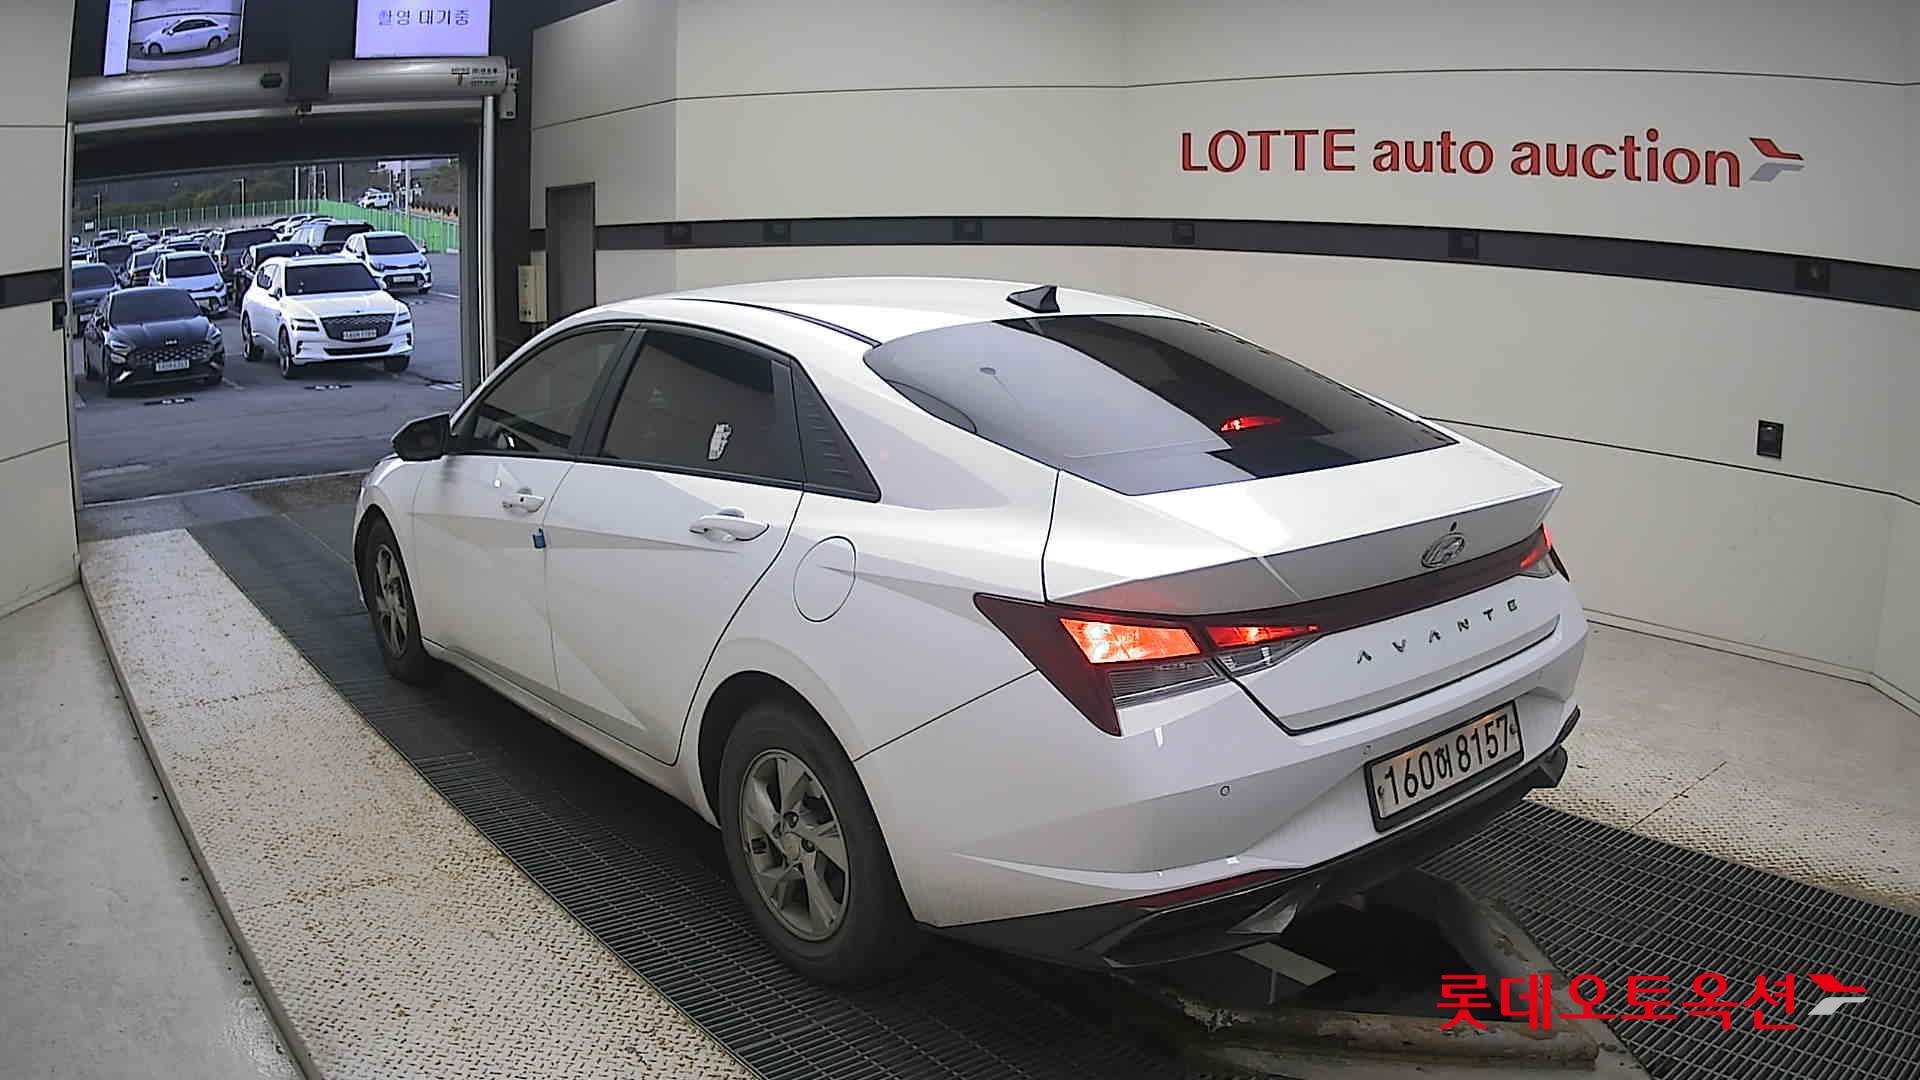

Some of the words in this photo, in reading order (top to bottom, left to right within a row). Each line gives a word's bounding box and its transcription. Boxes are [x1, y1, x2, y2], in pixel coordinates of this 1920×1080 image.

[419, 9, 469, 26] 대기중
[1182, 129, 1356, 173] LOTTE
[1373, 131, 1495, 176] auto
[1511, 129, 1742, 188] auction
[1356, 599, 1519, 664] AVANTE
